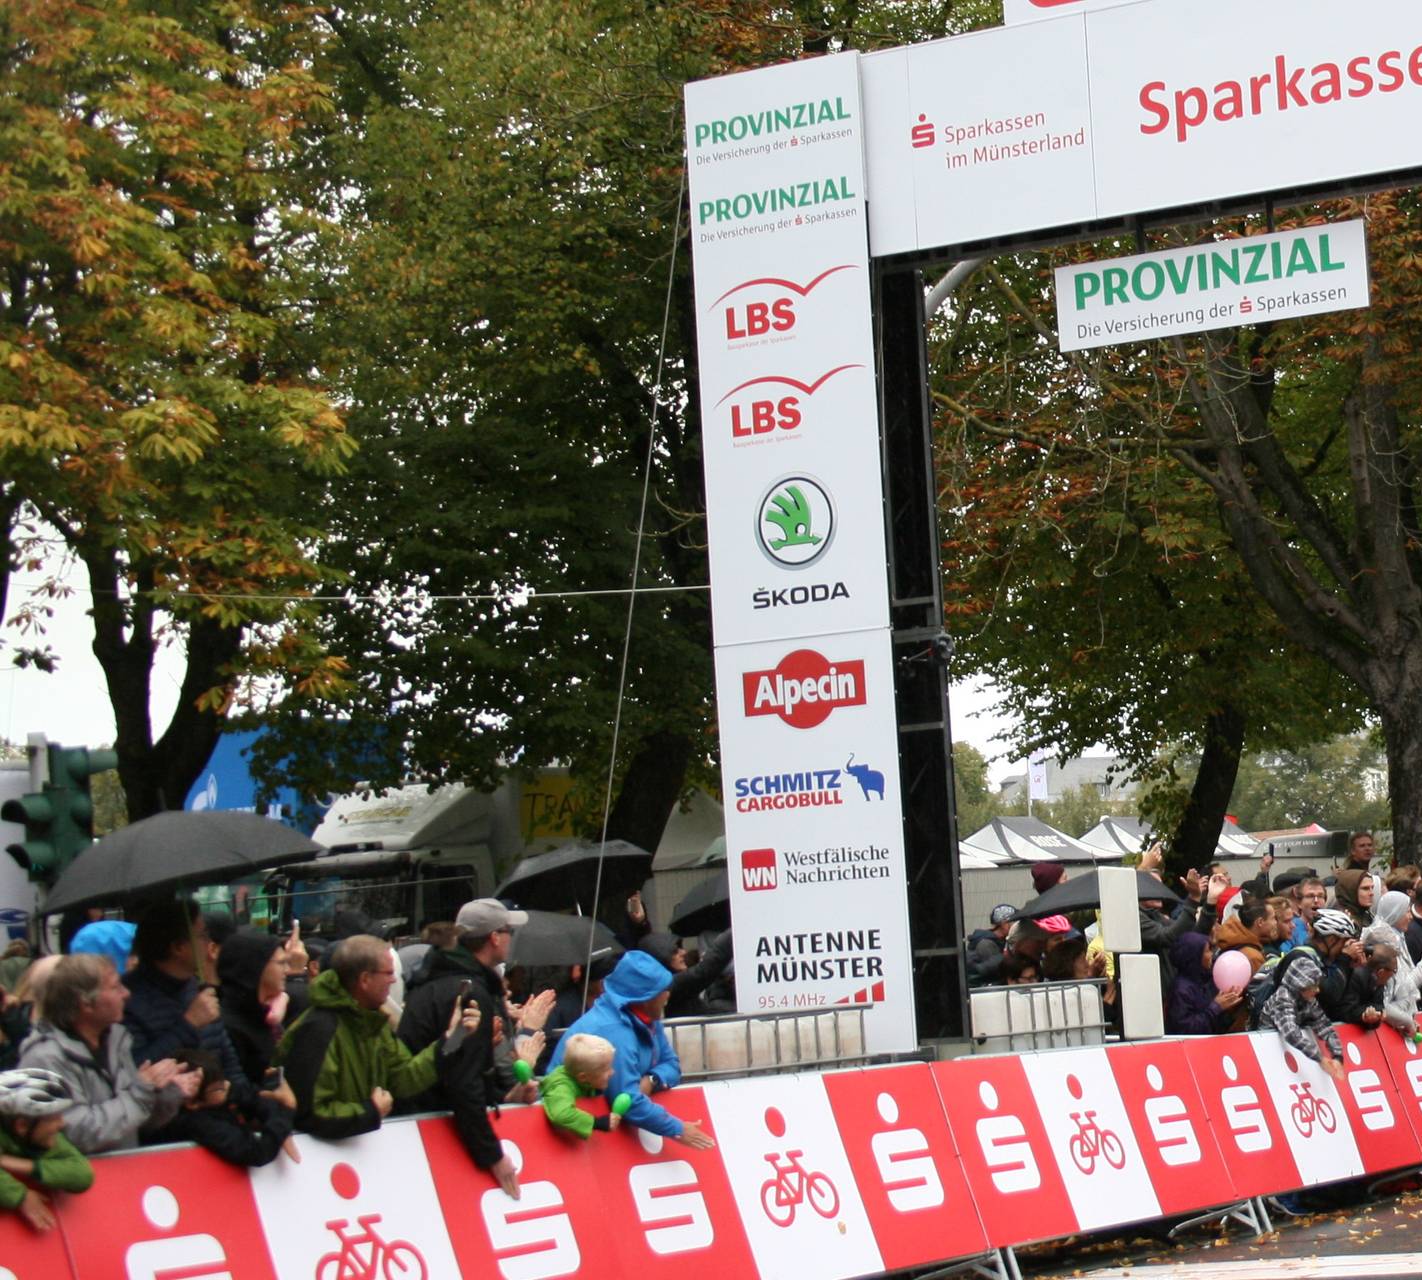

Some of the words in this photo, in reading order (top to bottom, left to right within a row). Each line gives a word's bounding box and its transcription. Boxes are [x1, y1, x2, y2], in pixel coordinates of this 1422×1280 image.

[695, 97, 851, 147] PROVINZIAL
[945, 113, 1044, 145] Sparkassen
[697, 156, 710, 165] Die
[713, 145, 770, 160] Versicherung
[773, 141, 787, 149] der
[801, 130, 852, 145] Sparkassen
[947, 153, 967, 168] im
[974, 128, 1084, 164] Münsterland
[699, 176, 855, 225] PROVINZIAL
[701, 234, 714, 242] Die
[717, 224, 774, 239] Versicherung
[778, 220, 791, 228] der
[805, 209, 856, 224] Sparkassen
[1074, 234, 1345, 311] PROVINZIAL
[726, 298, 795, 340] LBS
[1078, 325, 1101, 339] Die
[1105, 309, 1204, 334] Versicherung
[1209, 303, 1234, 318] der
[1257, 288, 1346, 312] Sparkassen
[731, 396, 801, 438] LBS
[753, 582, 850, 609] ŠKODA
[753, 667, 856, 714] Alpecin
[735, 769, 841, 797] SCHMITZ
[736, 791, 843, 813] CARGOBULL
[784, 845, 889, 866] Westfälische
[742, 866, 777, 888] WN
[786, 865, 890, 884] Nachrichten
[756, 929, 881, 957] ANTENNE
[757, 956, 883, 984] MÜNSTER
[759, 995, 788, 1008] 95.4
[794, 993, 826, 1007] MHz
